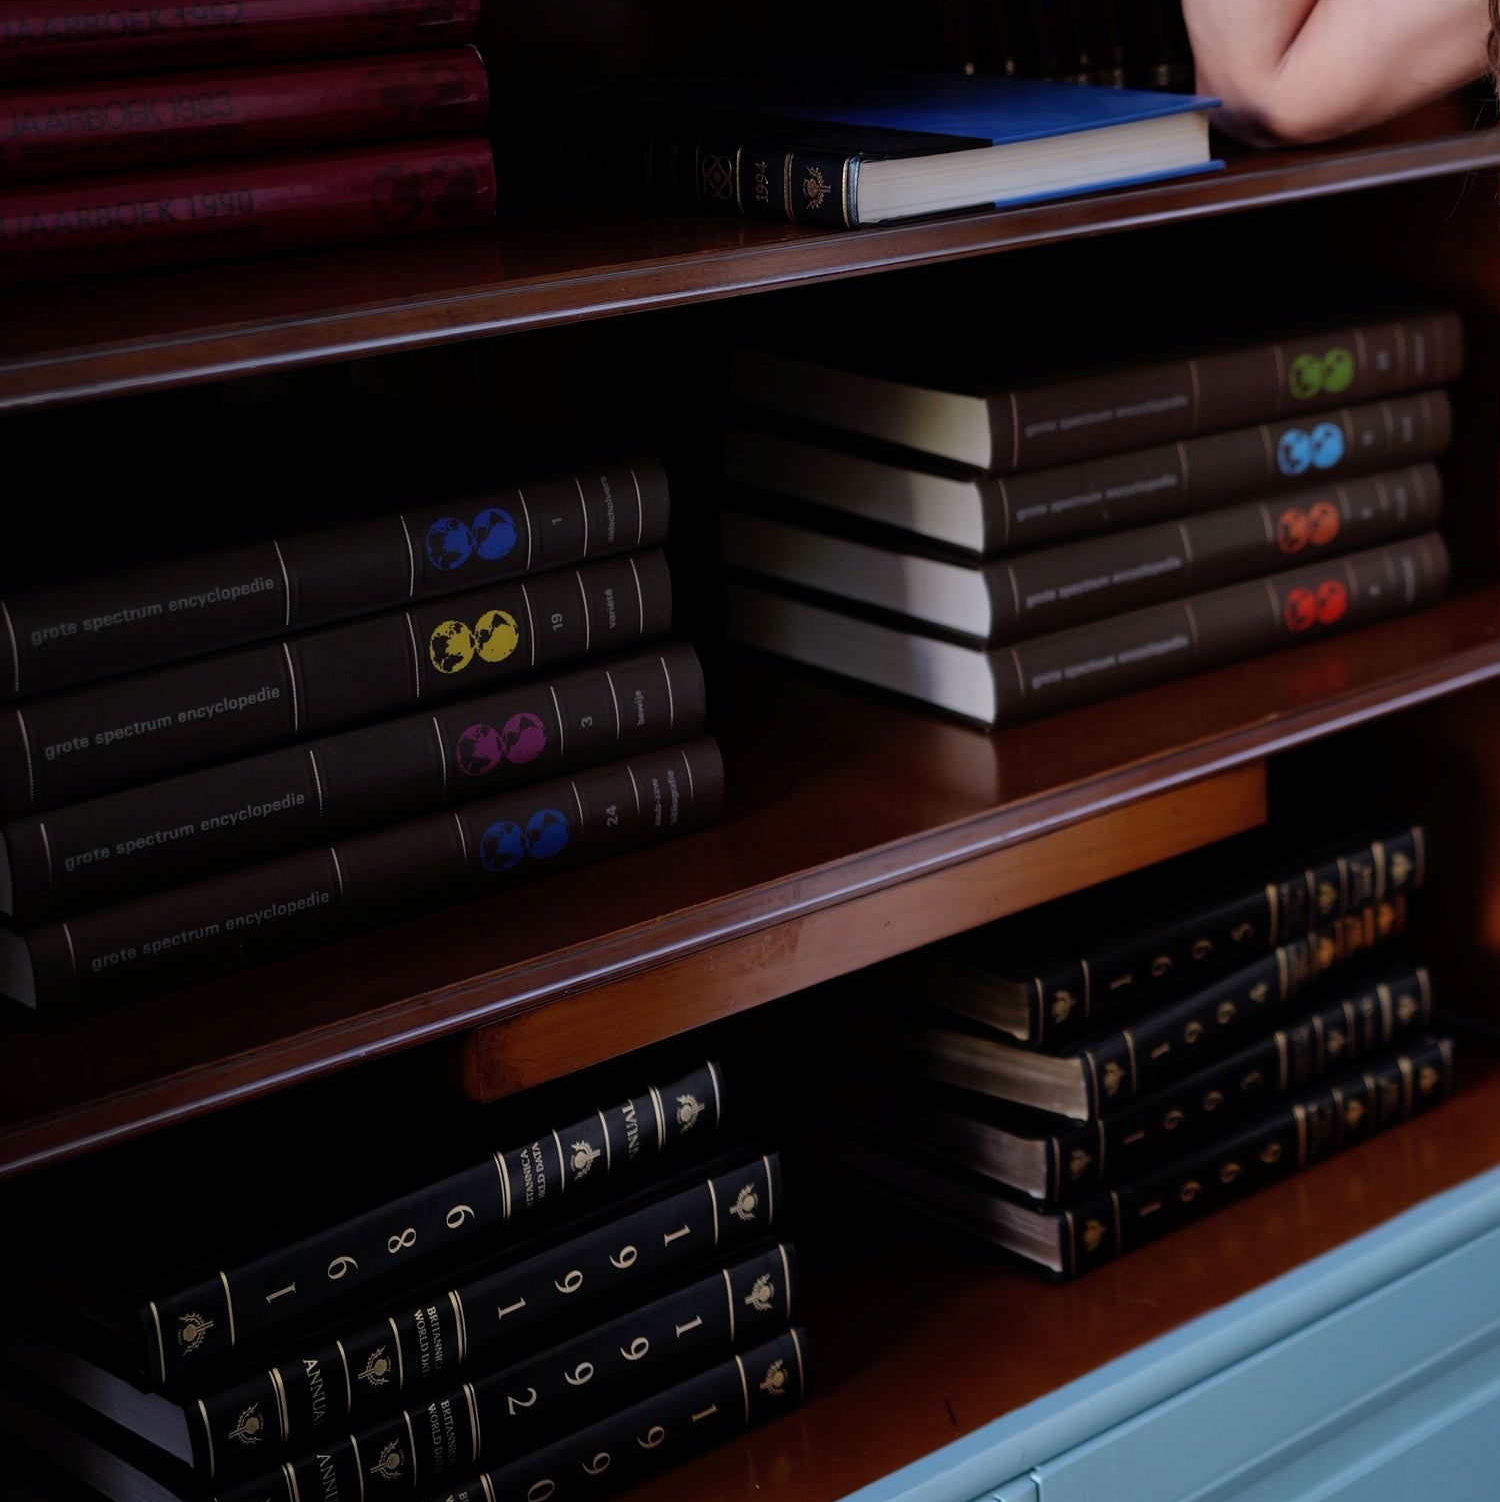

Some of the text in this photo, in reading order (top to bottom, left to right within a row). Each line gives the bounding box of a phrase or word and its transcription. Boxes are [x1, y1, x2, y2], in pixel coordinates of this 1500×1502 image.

[3, 89, 233, 139] JAARBOEK 1983
[189, 188, 254, 219] 1990
[551, 517, 562, 527] 1
[31, 577, 274, 646] grote spectrum encyclopedie
[550, 613, 563, 632] 19
[44, 686, 281, 759] grote spectrum encyclopedie
[580, 716, 593, 728] 3
[64, 792, 304, 872] grote spectrum encyclopedie
[606, 804, 618, 827] 24
[91, 890, 330, 972] grote spectrum encyclopedie
[414, 1309, 430, 1351] WORLD
[426, 1403, 441, 1445] WORLD
